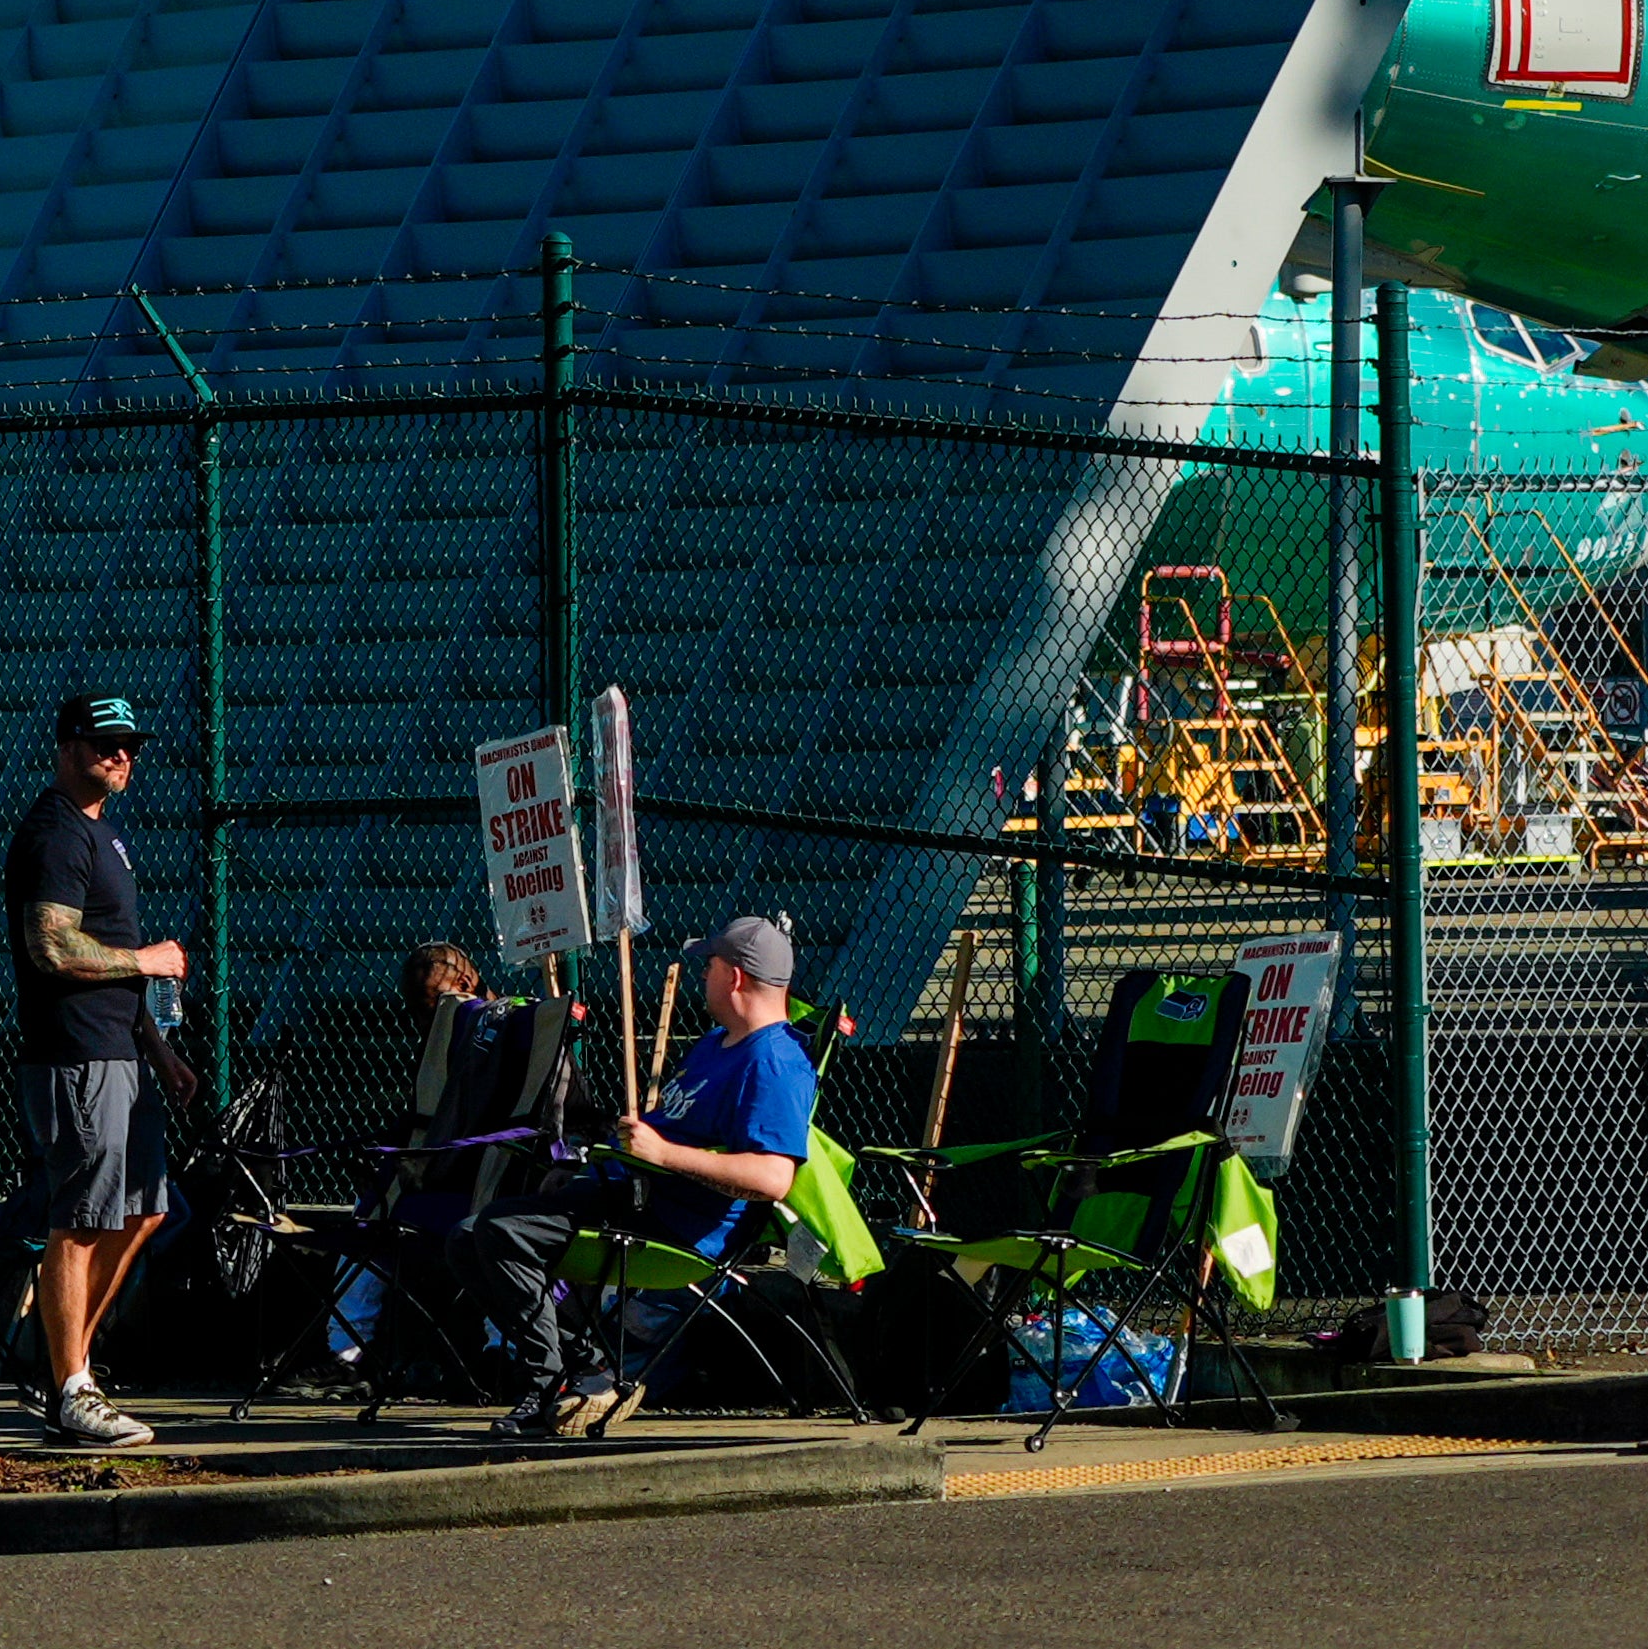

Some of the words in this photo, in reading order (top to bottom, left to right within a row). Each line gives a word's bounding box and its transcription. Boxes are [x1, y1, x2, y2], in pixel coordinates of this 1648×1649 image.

[480, 742, 530, 767] MACHINISTS
[506, 761, 537, 803] ON
[489, 798, 566, 853] STRIKE
[513, 845, 549, 869] AGAINST
[504, 864, 564, 903] Boeing
[1242, 942, 1296, 960] MACHINISTS
[1297, 941, 1330, 953] UNION
[1257, 963, 1294, 1001] ON
[1245, 1006, 1311, 1045] RIKE
[1240, 1050, 1277, 1066] GAINST
[1235, 1068, 1284, 1098] eing
